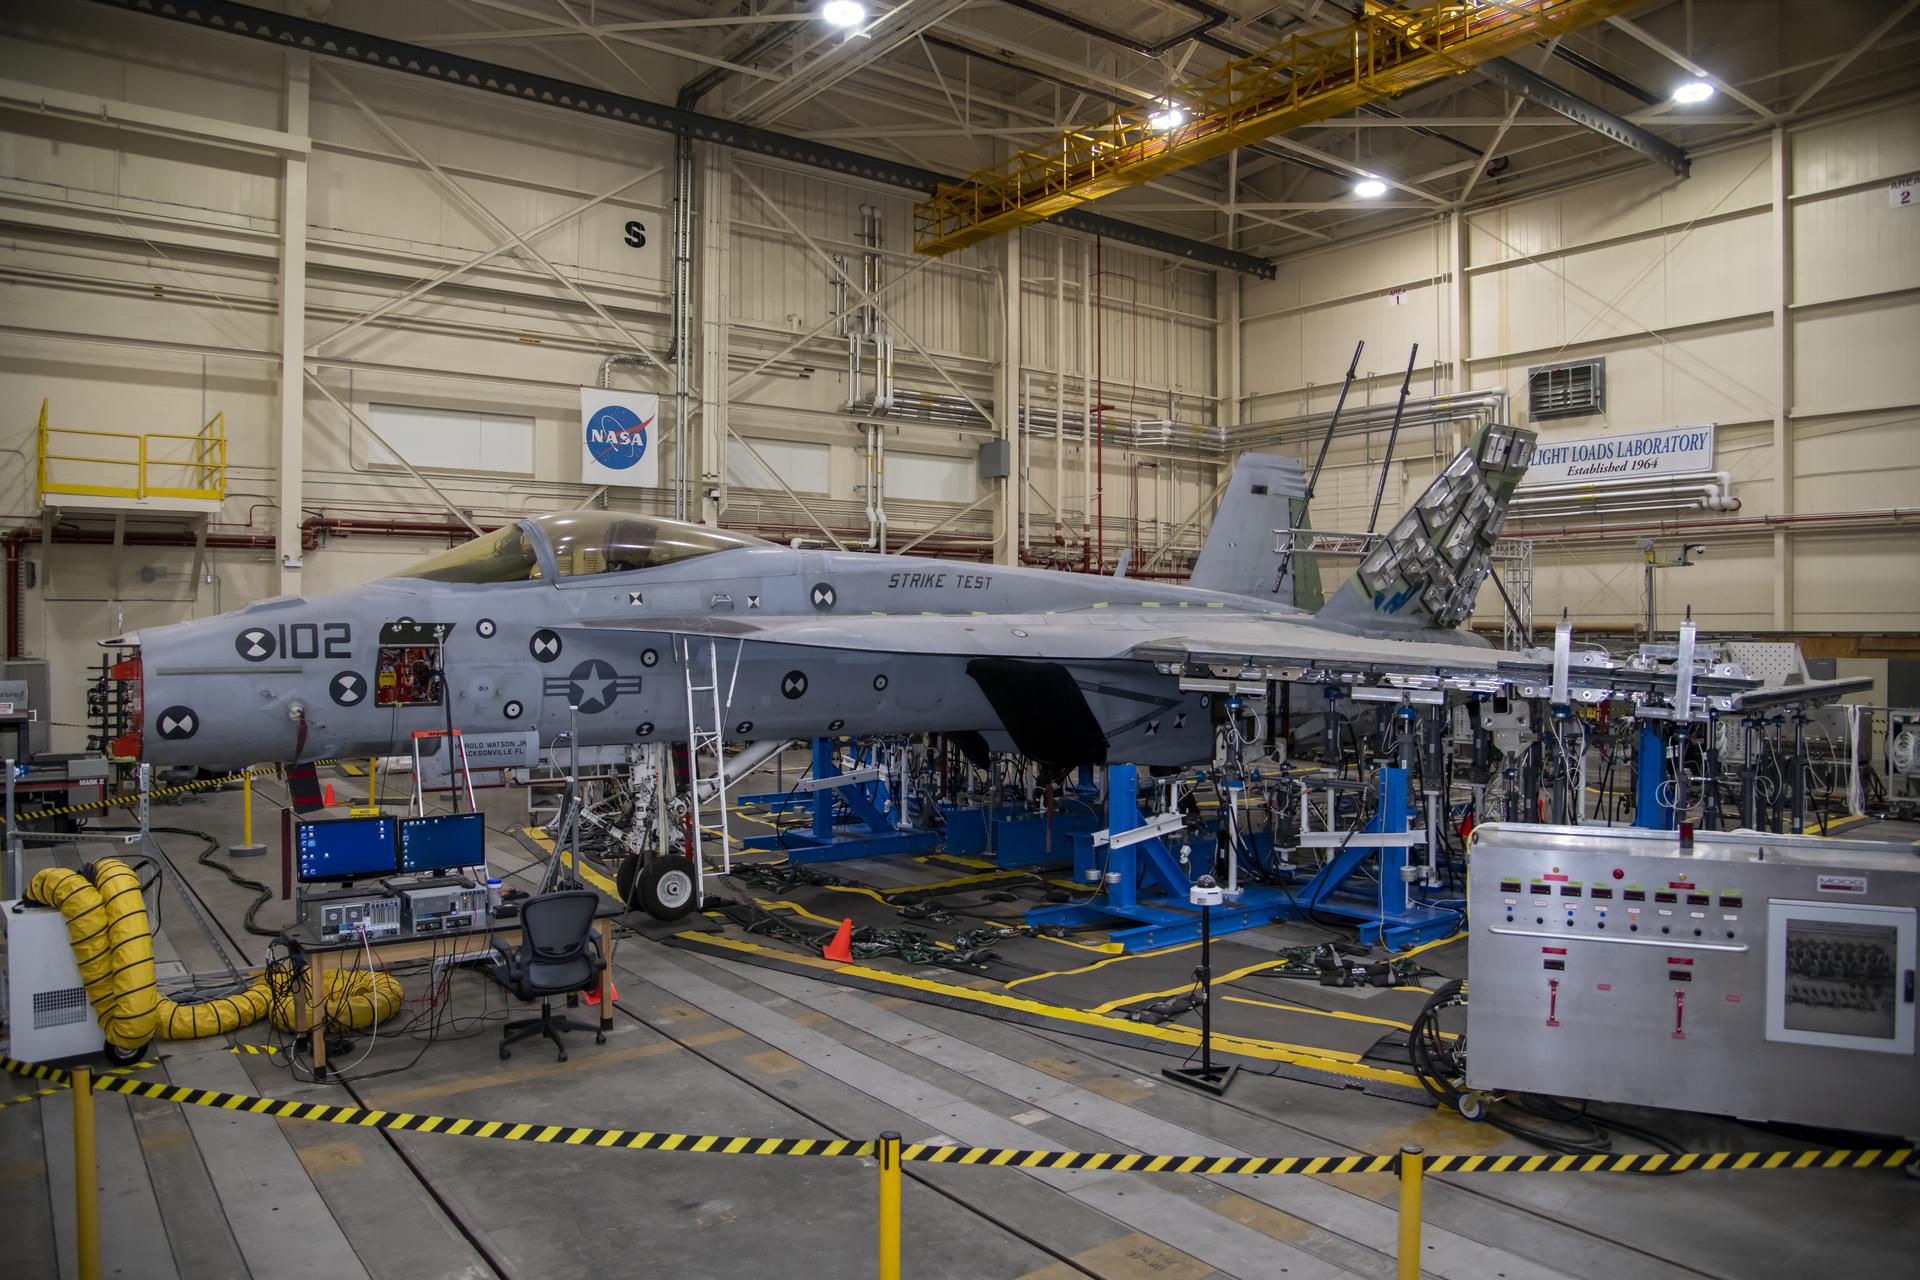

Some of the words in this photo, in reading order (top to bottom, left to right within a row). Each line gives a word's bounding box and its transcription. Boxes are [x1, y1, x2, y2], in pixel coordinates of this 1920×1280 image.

[1901, 191, 1911, 204] 2
[624, 220, 646, 248] S
[591, 429, 643, 447] NASA
[1530, 446, 1569, 466] LIGHT
[1572, 442, 1614, 462] LOADS
[1617, 432, 1709, 458] LABORATORY
[1567, 460, 1628, 476] Established
[1631, 457, 1659, 471] 1964
[888, 573, 946, 588] STRIKE
[956, 574, 993, 589] TEST
[279, 623, 352, 659] 102
[455, 742, 484, 750] HROLD
[458, 748, 512, 757] CKSONVILLE
[514, 747, 524, 755] FL
